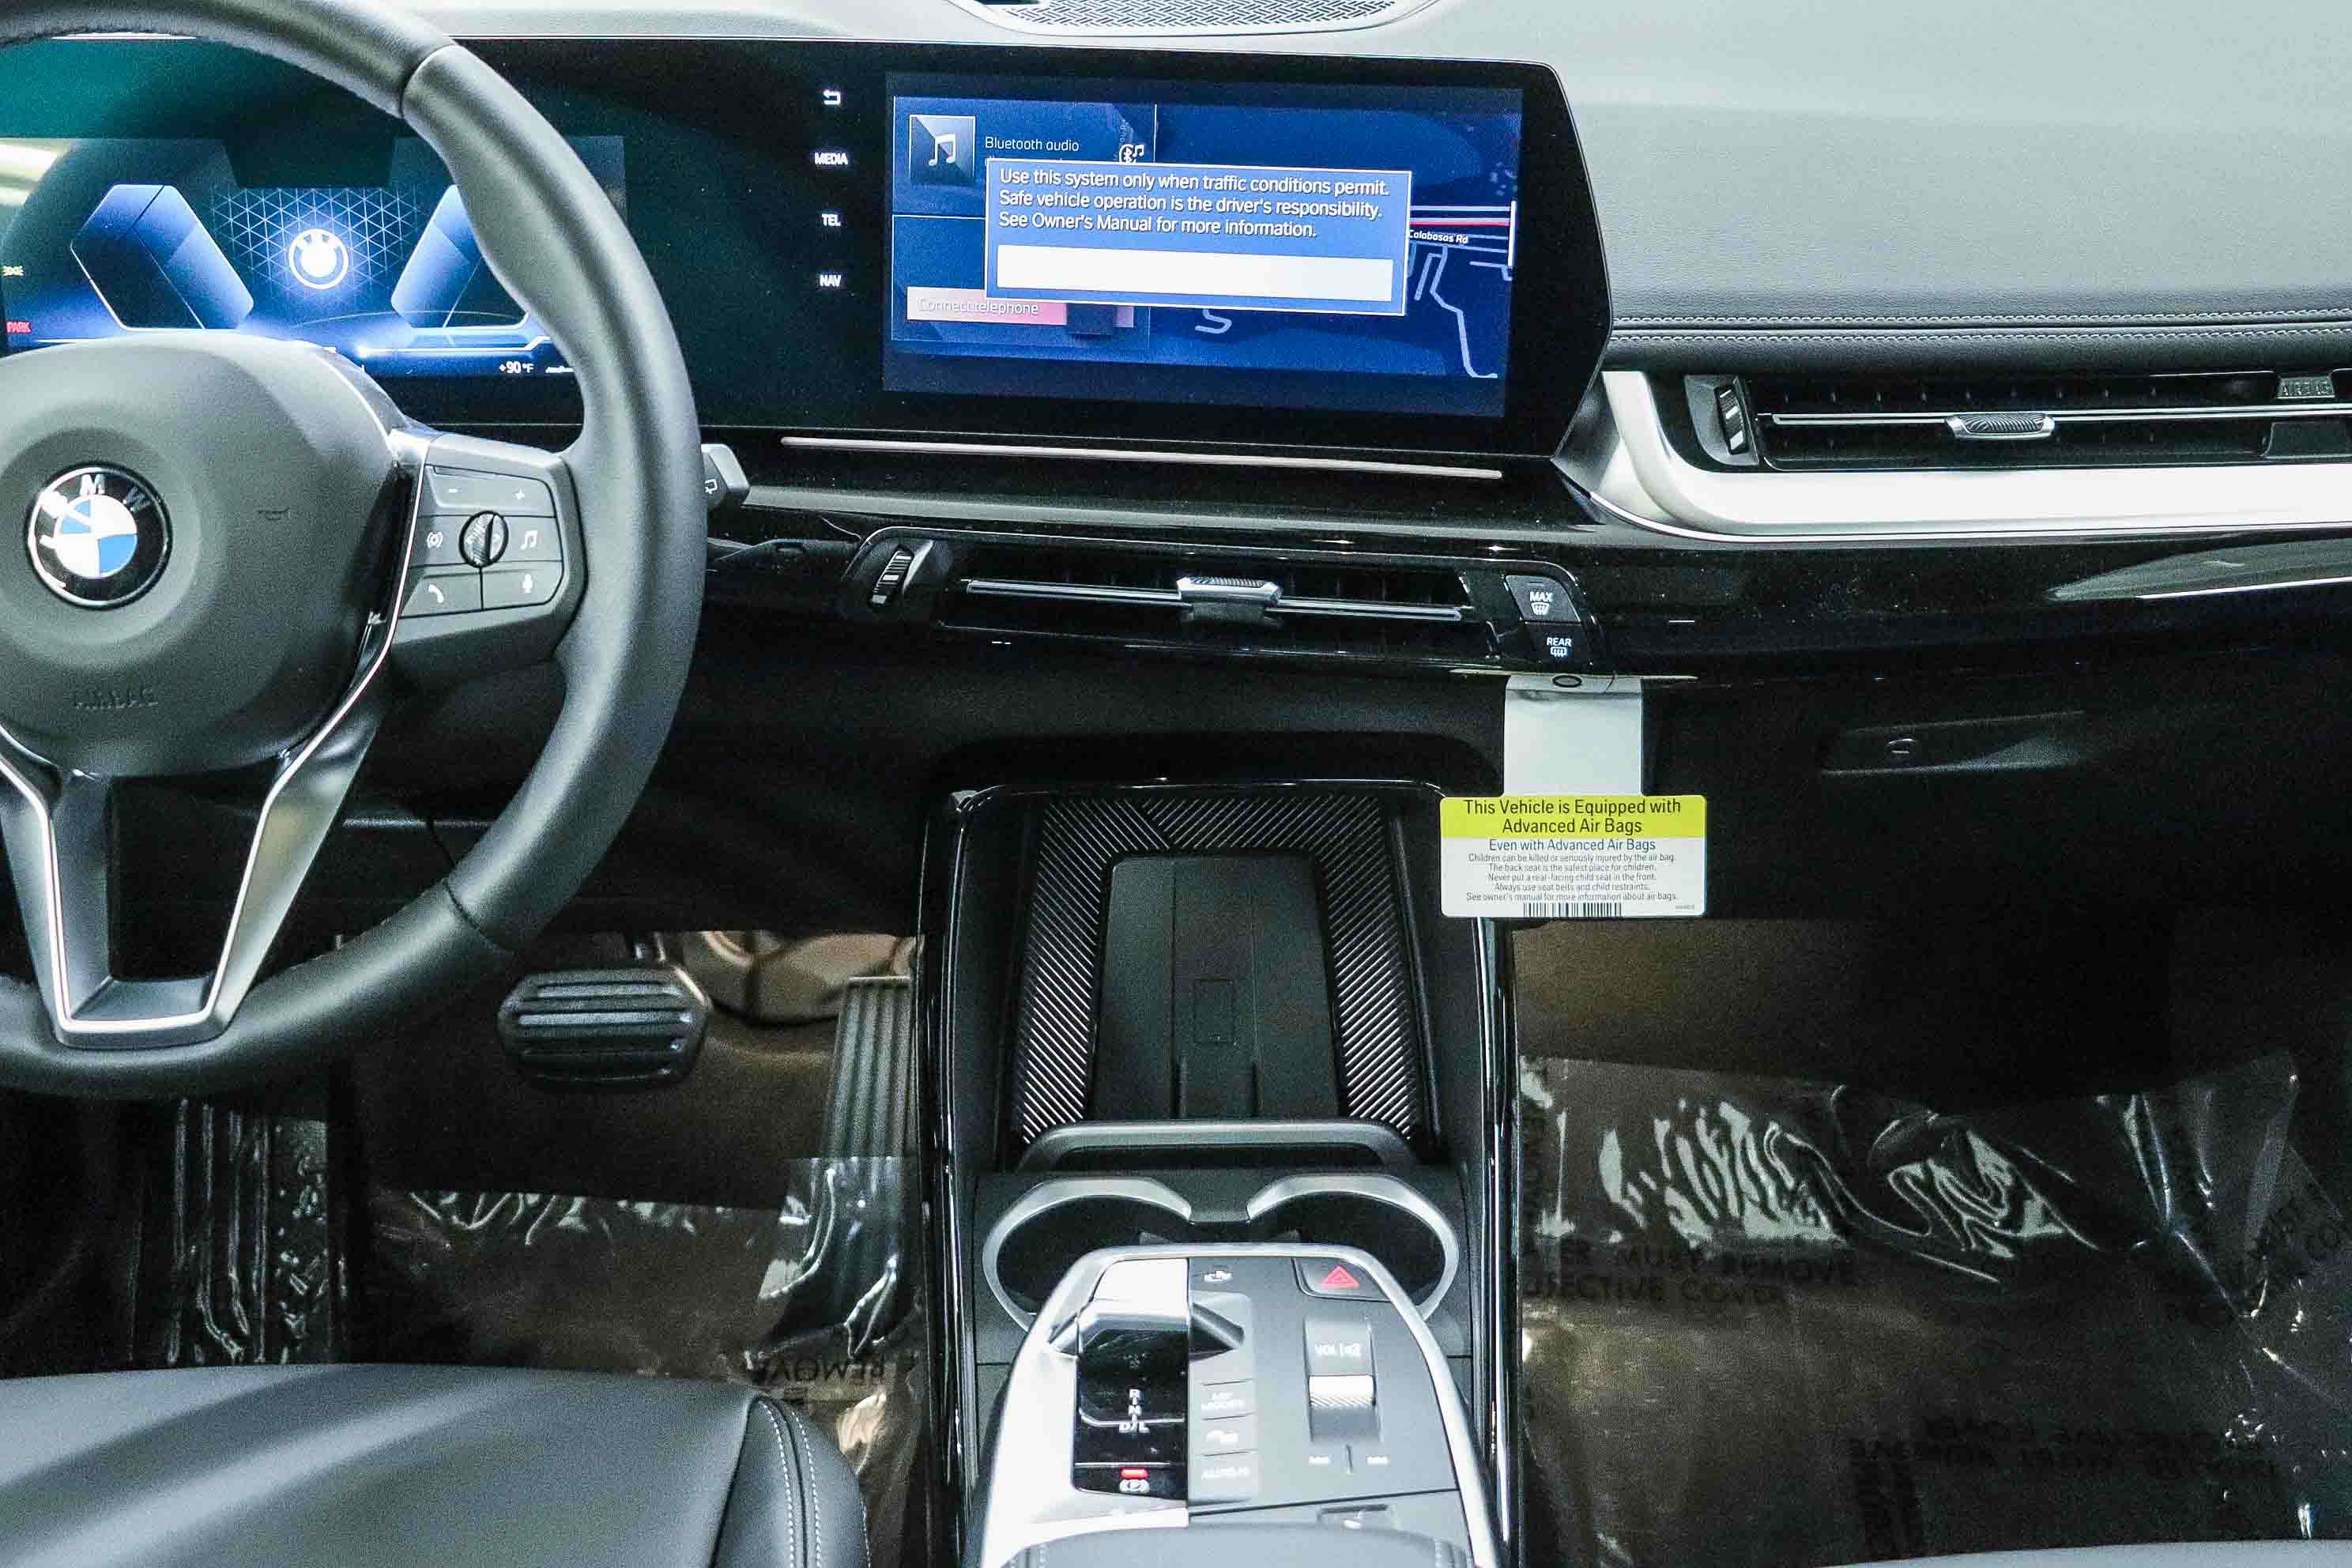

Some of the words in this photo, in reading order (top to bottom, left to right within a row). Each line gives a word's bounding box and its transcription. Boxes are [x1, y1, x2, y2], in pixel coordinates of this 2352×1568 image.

[985, 136, 1043, 150] Bluetooth
[1046, 139, 1080, 152] audio
[814, 152, 849, 165] MEDIA
[999, 168, 1030, 185] Use
[1033, 169, 1062, 187] this
[1065, 171, 1119, 191] system
[1122, 172, 1155, 191] only
[1158, 173, 1199, 190] when
[1202, 175, 1246, 192] traffic
[1250, 177, 1332, 194] conditions
[1334, 180, 1391, 197] permit.
[999, 189, 1033, 206] Safe
[1036, 191, 1091, 209] vehicle
[1093, 194, 1167, 212] operation
[1170, 195, 1184, 211] is
[1187, 196, 1212, 212] the
[1216, 198, 1272, 215] driver's
[1276, 201, 1382, 221] responsibility.
[821, 213, 842, 226] TEL
[998, 211, 1028, 228] See
[1031, 213, 1094, 230] Owner's
[1096, 214, 1152, 232] Manual
[1155, 216, 1178, 232] for
[1181, 220, 1221, 235] more
[1225, 220, 1317, 238] information.
[1455, 233, 1468, 244] Rd
[819, 274, 842, 288] NAV
[974, 300, 1039, 316] telephone
[1529, 591, 1555, 602] MAX
[1546, 636, 1572, 647] REAR
[1462, 798, 1496, 815] This
[1499, 798, 1555, 814] Vehicle
[1559, 799, 1570, 814] is
[1574, 798, 1645, 817] Equipped
[1649, 797, 1681, 813] with
[1502, 817, 1575, 833] Advanced
[1579, 817, 1600, 833] Air
[1604, 817, 1642, 836] Bags
[1489, 838, 1517, 851] Even
[1520, 838, 1544, 851] with
[1547, 838, 1604, 851] Advanced
[1607, 838, 1623, 851] Air
[1626, 838, 1657, 854] Bags
[1468, 853, 1500, 862] Children
[1517, 853, 1527, 862] be
[1528, 853, 1549, 862] killed
[1623, 853, 1632, 864] by
[1634, 853, 1646, 862] the
[1488, 863, 1505, 872] The
[1504, 863, 1522, 872] back
[1550, 863, 1562, 872] the
[1494, 882, 1521, 892] Always
[1576, 883, 1590, 891] and
[1592, 882, 1610, 891] child
[1466, 891, 1482, 901] See
[1544, 892, 1554, 901] for
[1623, 891, 1645, 901] about
